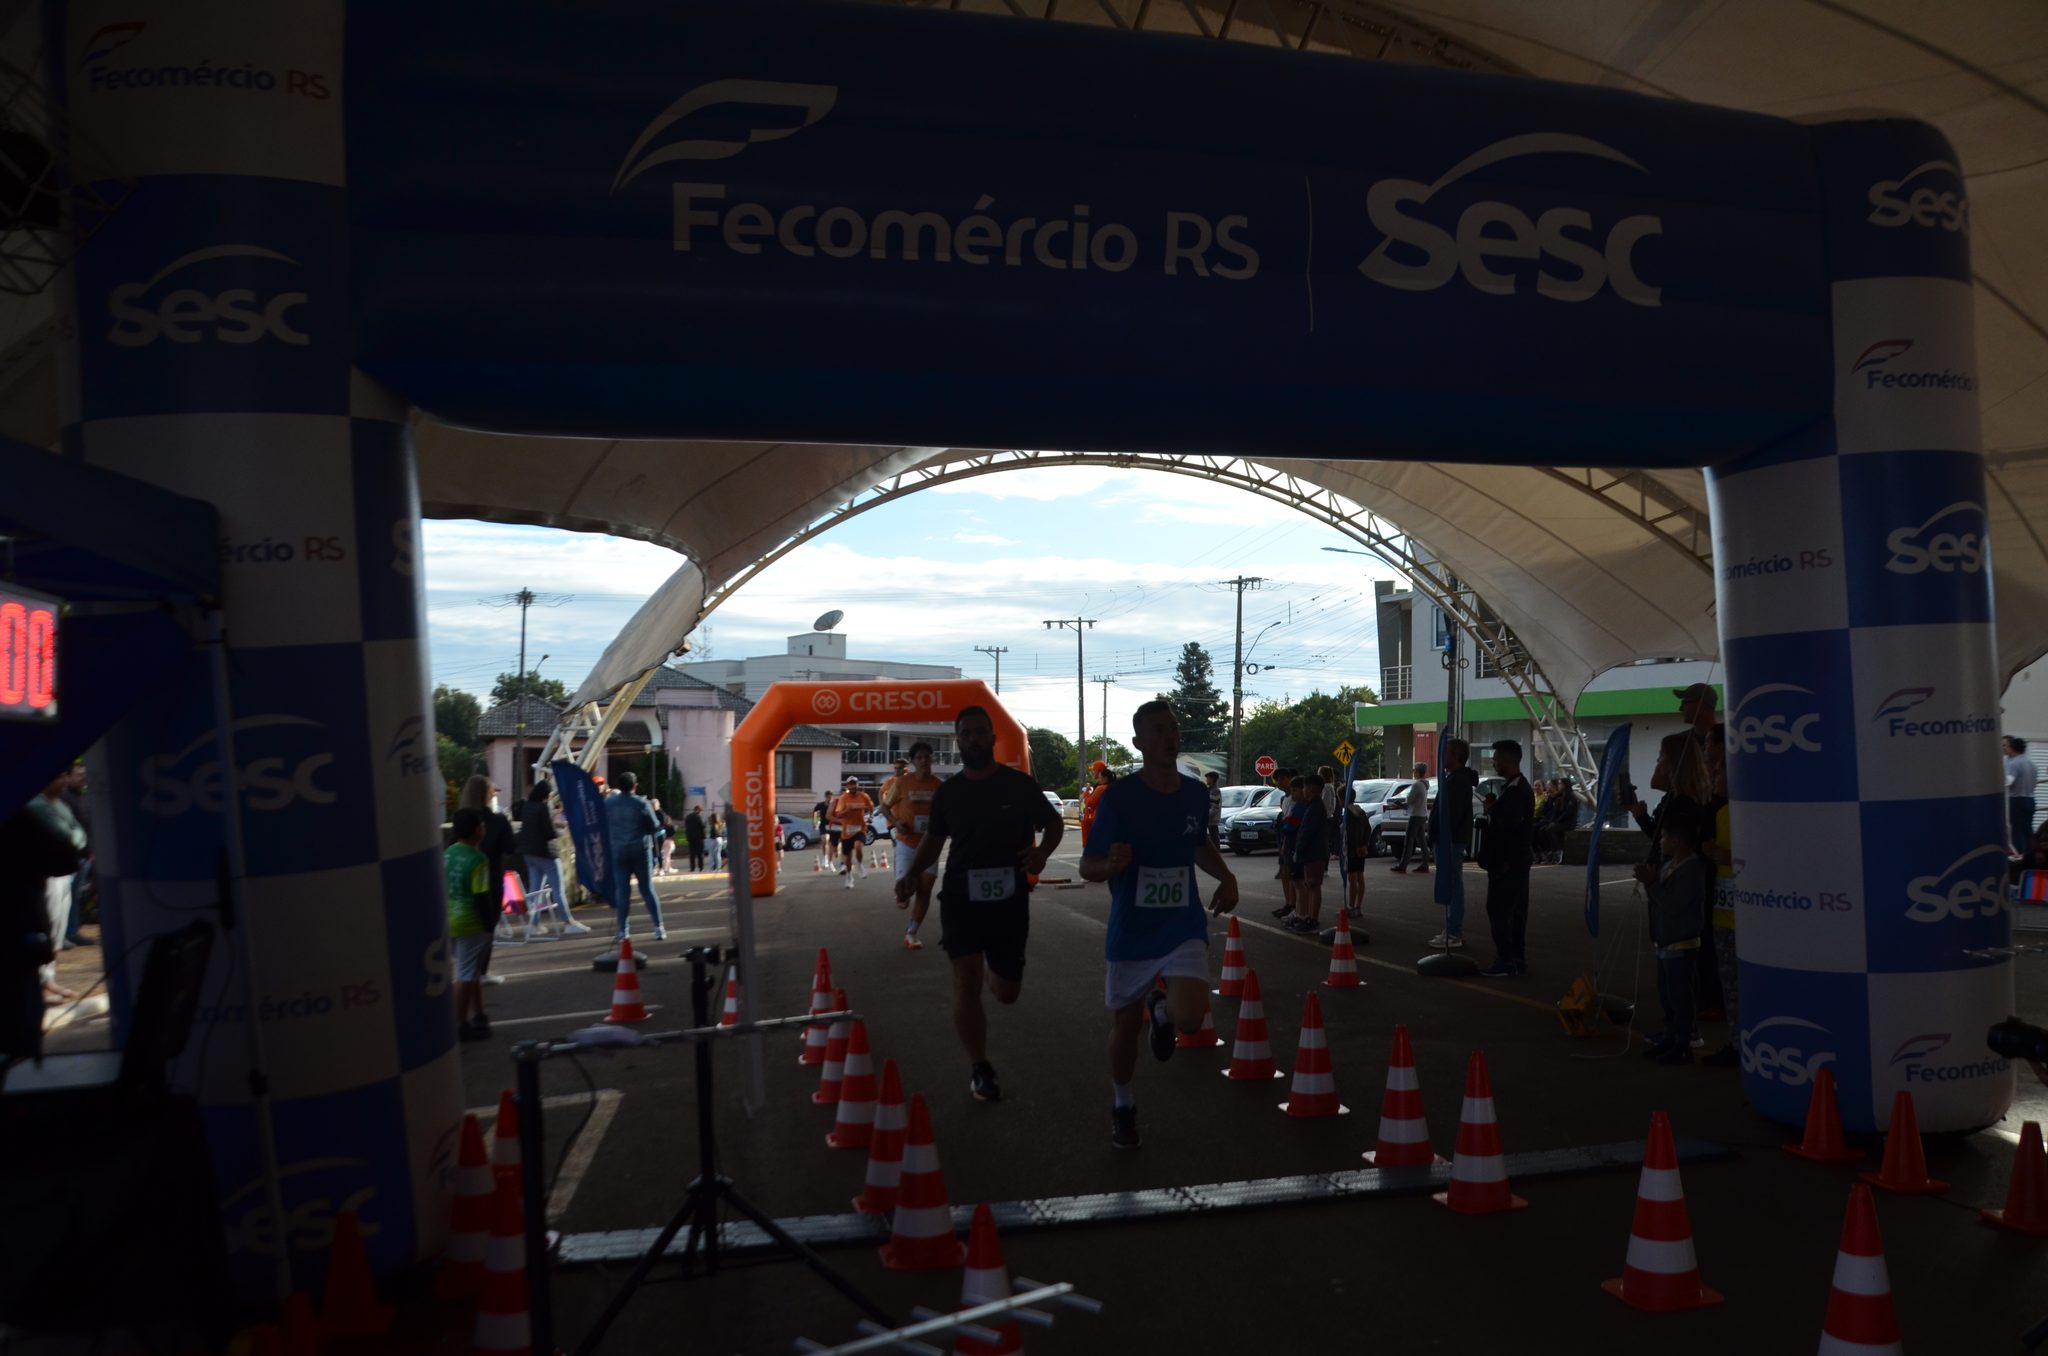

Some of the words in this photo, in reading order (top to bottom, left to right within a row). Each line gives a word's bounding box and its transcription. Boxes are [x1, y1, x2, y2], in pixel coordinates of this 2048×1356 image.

[90, 61, 275, 92] Fecomércio
[287, 69, 330, 100] RS
[673, 182, 1138, 273] Fecomércio
[1164, 211, 1261, 281] RS
[304, 536, 346, 562] RS
[1800, 549, 1833, 569] RS
[1884, 526, 1987, 575] Ses
[848, 689, 951, 712] CRESOL
[1256, 761, 1275, 771] PARE
[746, 763, 765, 850] CRESOL
[981, 880, 1004, 899] 95
[1143, 882, 1183, 905] 206
[1819, 892, 1853, 912] RS
[341, 980, 381, 1009] RS
